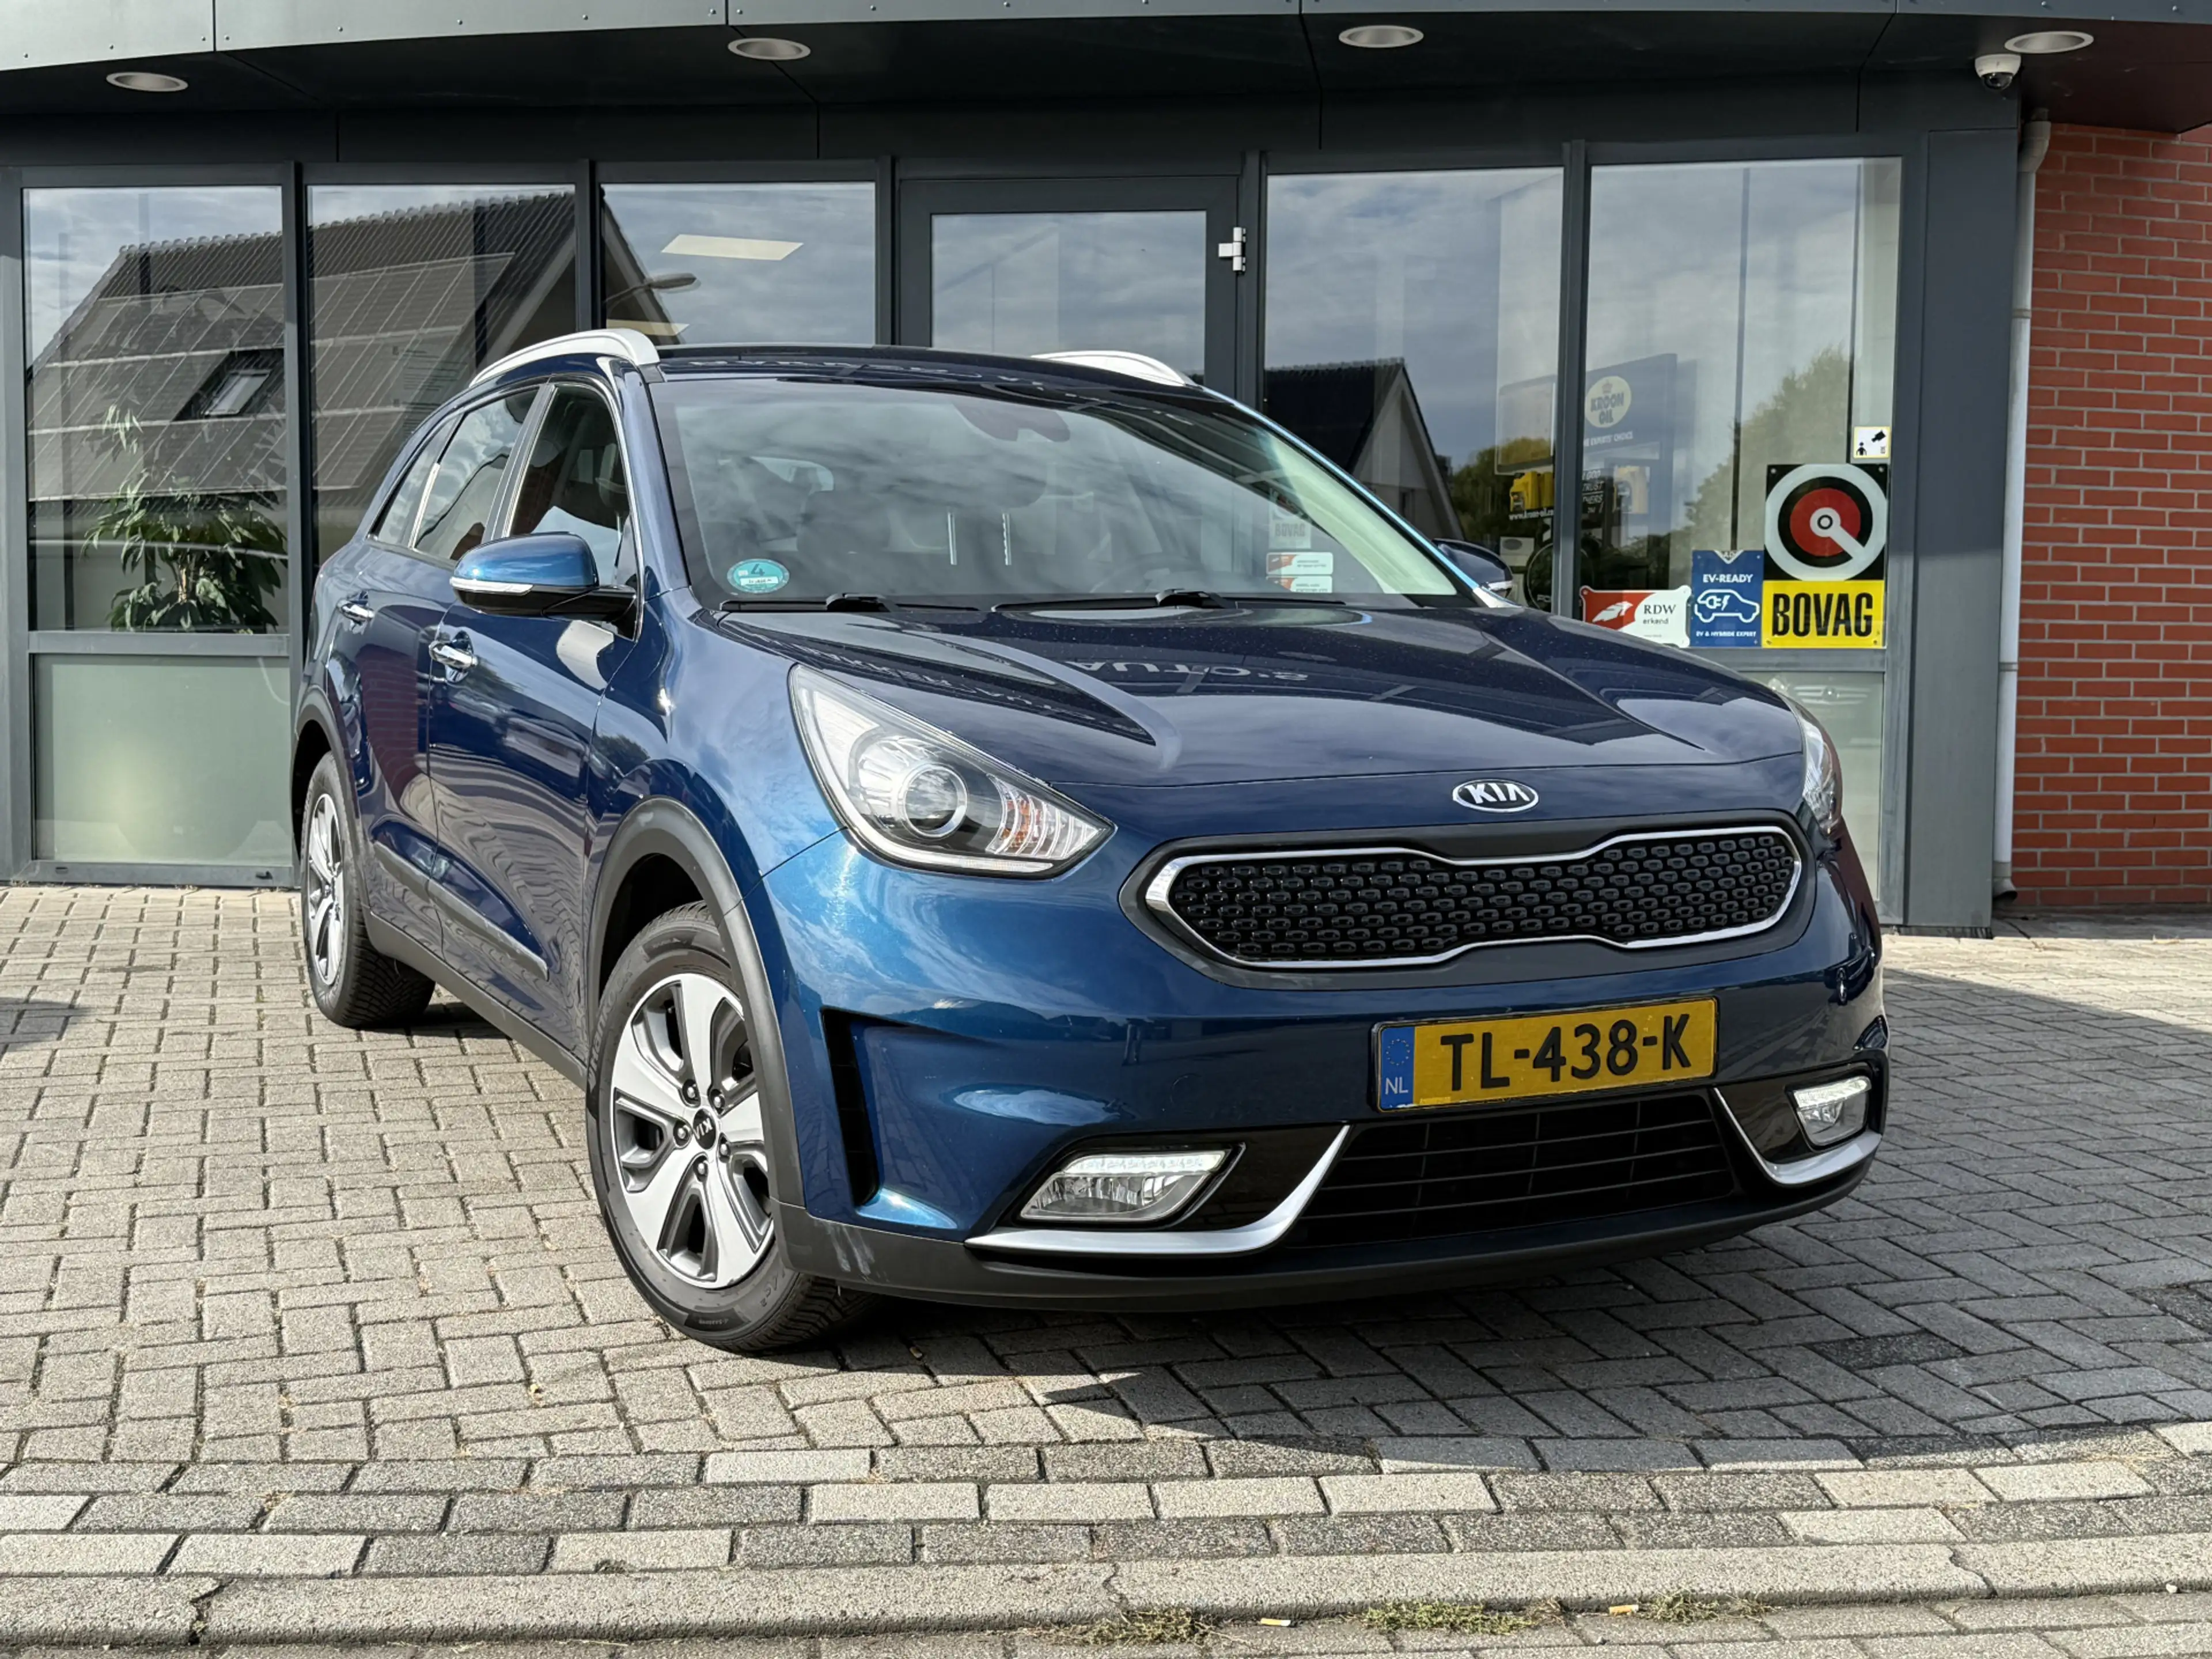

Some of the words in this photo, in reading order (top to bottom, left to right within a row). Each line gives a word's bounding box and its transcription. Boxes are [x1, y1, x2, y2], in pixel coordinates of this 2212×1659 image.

[1590, 393, 1624, 412] KROON
[1599, 410, 1614, 425] OIL
[751, 564, 766, 577] 4
[1703, 574, 1753, 583] EV-READY
[1643, 604, 1676, 615] RDW
[1772, 593, 1873, 637] BOVAG
[1465, 783, 1530, 804] KIA
[1440, 1013, 1692, 1092] TL-438-K
[1385, 1076, 1408, 1095] NL
[693, 1118, 713, 1140] KIA
